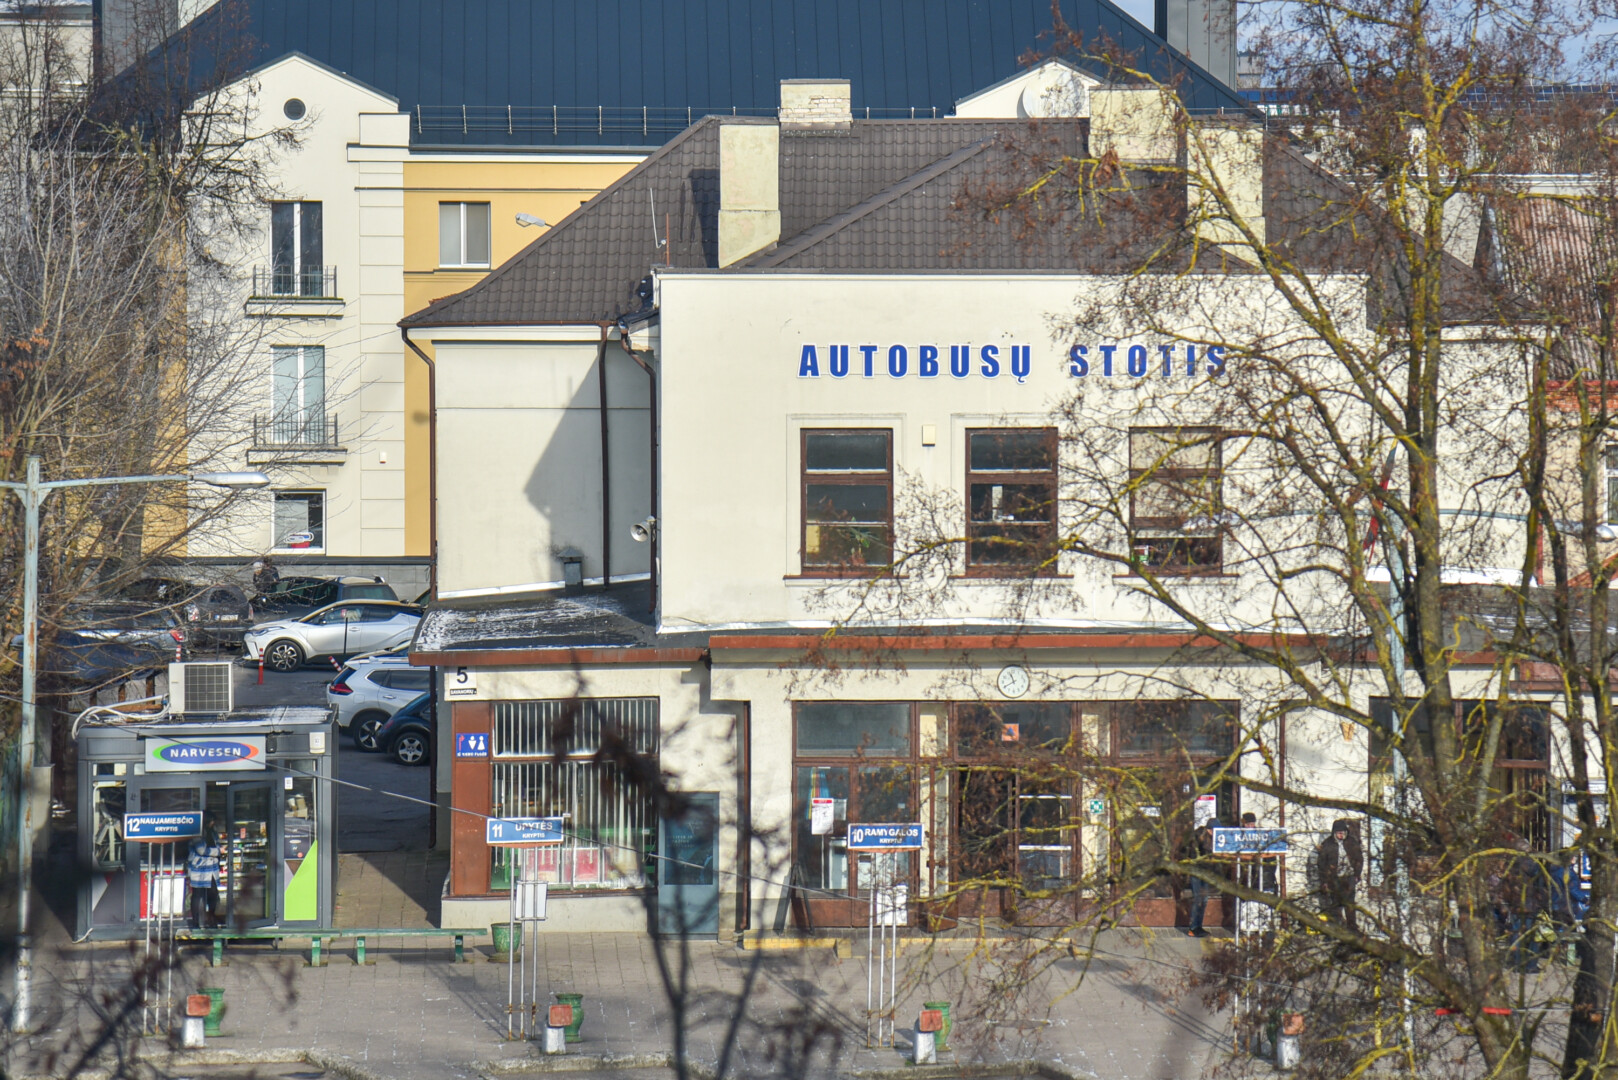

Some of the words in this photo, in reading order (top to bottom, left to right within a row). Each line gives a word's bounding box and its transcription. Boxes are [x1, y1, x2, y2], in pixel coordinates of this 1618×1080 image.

[798, 344, 1031, 384] AUTOBUSŲ
[1069, 344, 1226, 378] STOTIS
[457, 666, 468, 684] 5
[170, 747, 241, 758] NARVESEN
[127, 818, 140, 832] 12
[140, 816, 194, 825] NAUJAMIESČIO
[492, 823, 503, 838] 11
[515, 820, 553, 831] UPYTĖS
[852, 829, 864, 843] 10
[864, 828, 919, 837] RAMYGALOS
[1217, 834, 1226, 848] 9
